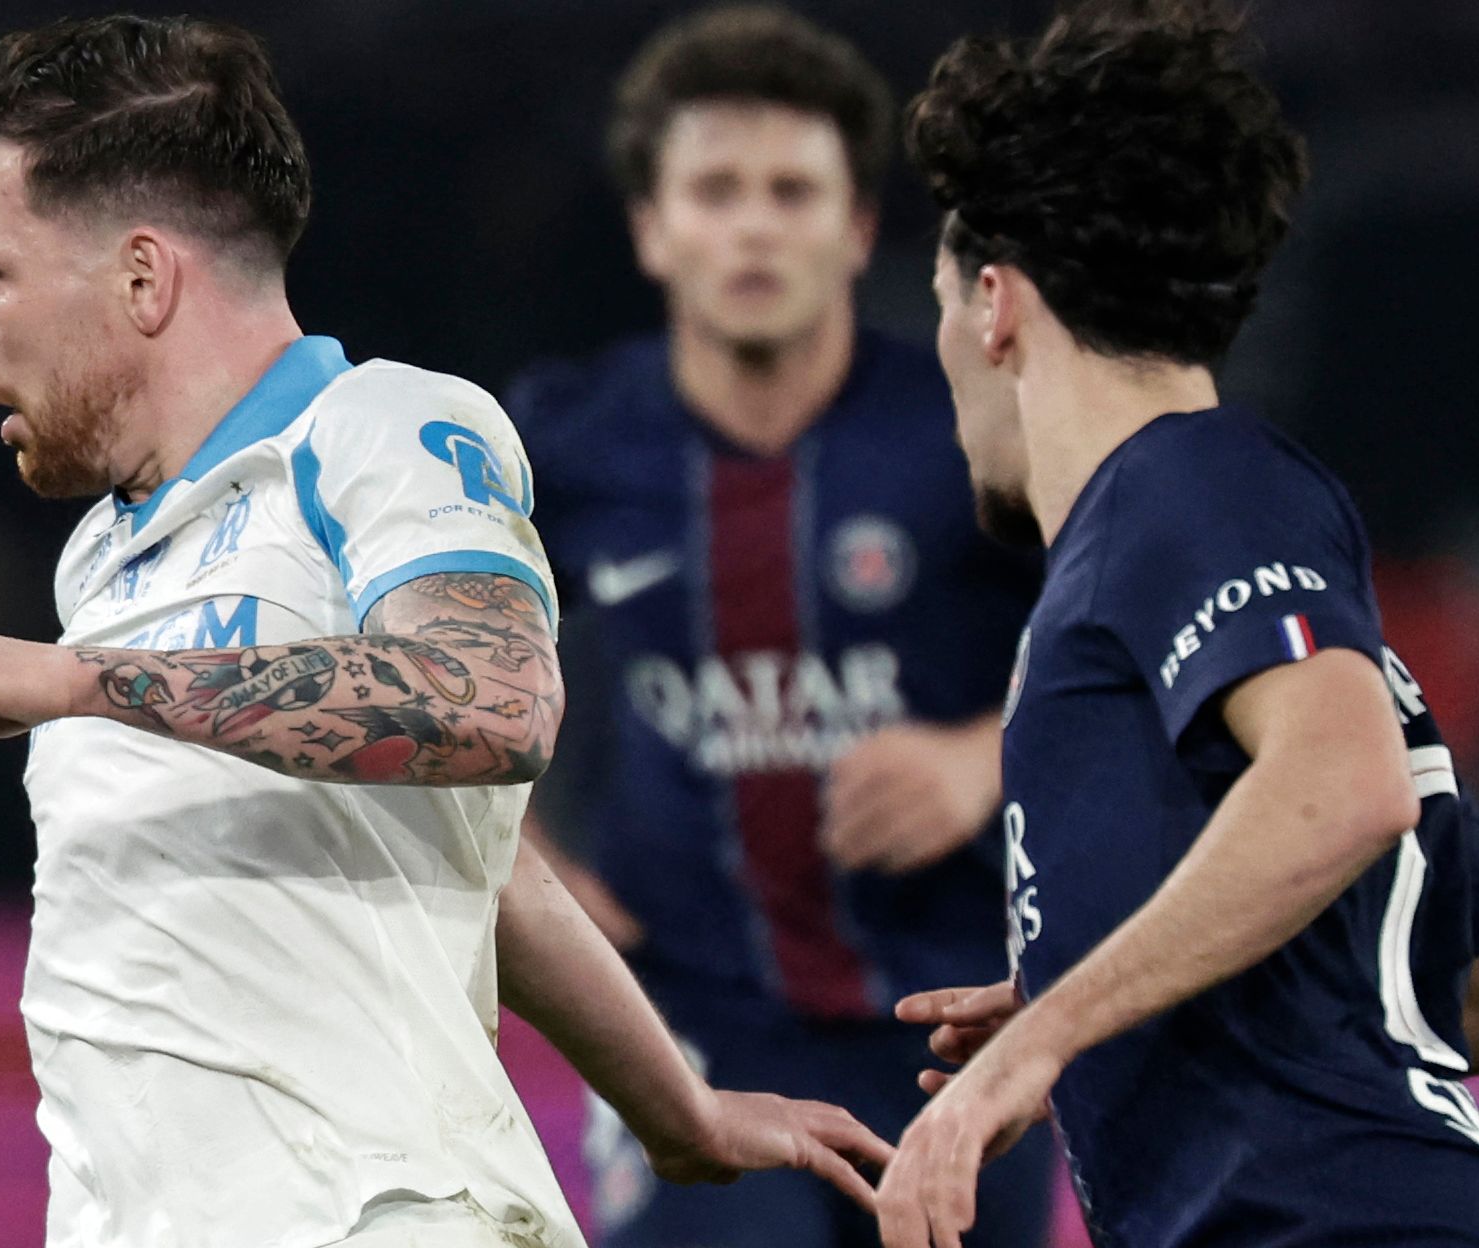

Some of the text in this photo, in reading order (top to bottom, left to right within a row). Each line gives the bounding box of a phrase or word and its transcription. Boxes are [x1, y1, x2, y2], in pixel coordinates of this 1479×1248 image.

[428, 505, 463, 519] D'OR
[467, 507, 483, 516] ET
[1159, 561, 1327, 689] BEYOND
[624, 644, 908, 748] QATAR
